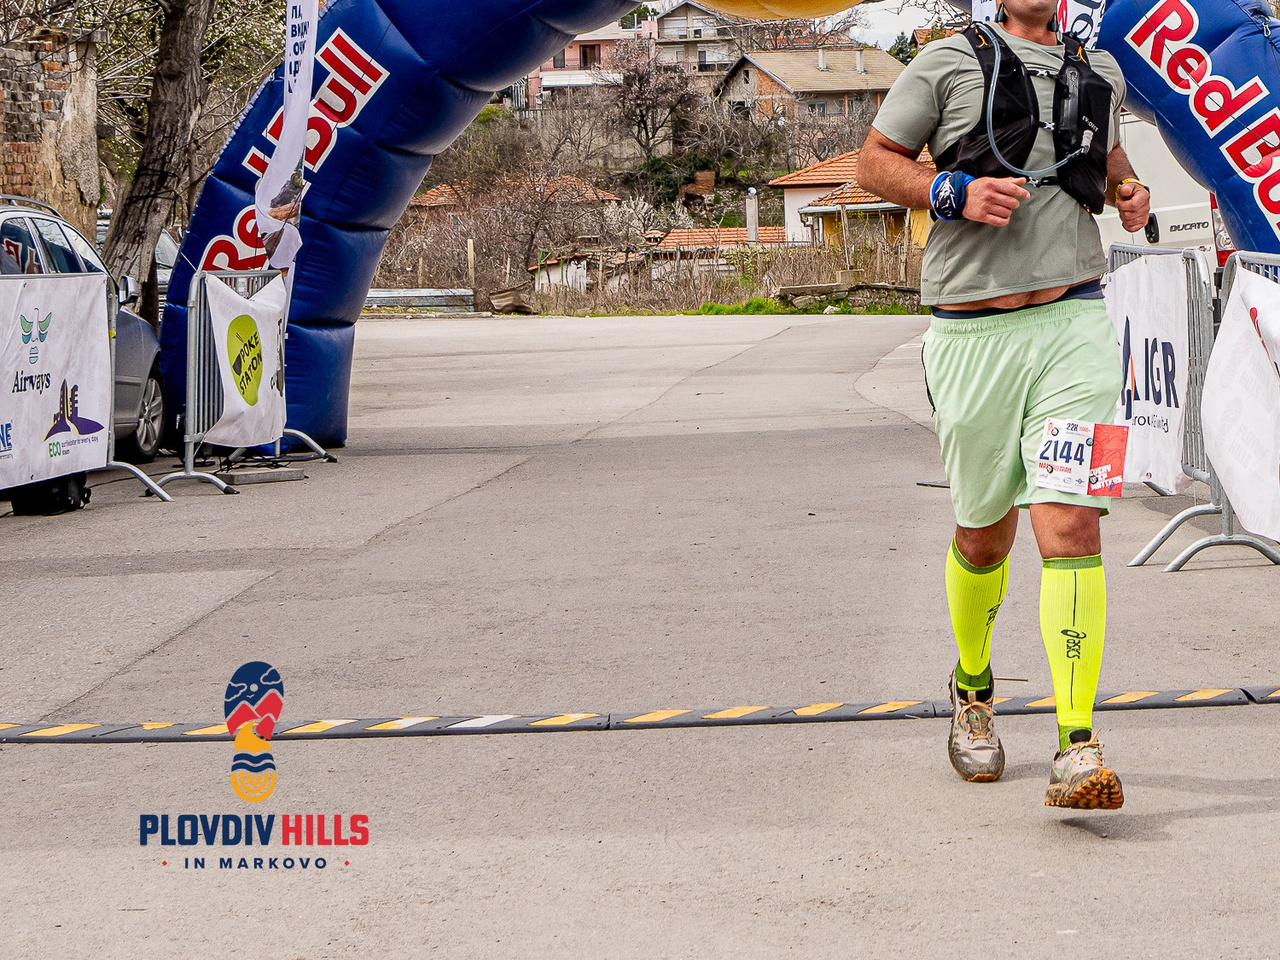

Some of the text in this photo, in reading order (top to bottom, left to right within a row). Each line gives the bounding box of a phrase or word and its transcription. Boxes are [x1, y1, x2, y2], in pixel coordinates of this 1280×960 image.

[1169, 220, 1209, 233] DUCATO
[240, 331, 260, 362] POKE
[12, 370, 51, 395] Airways
[48, 442, 62, 458] ECO
[1039, 439, 1085, 466] 2144
